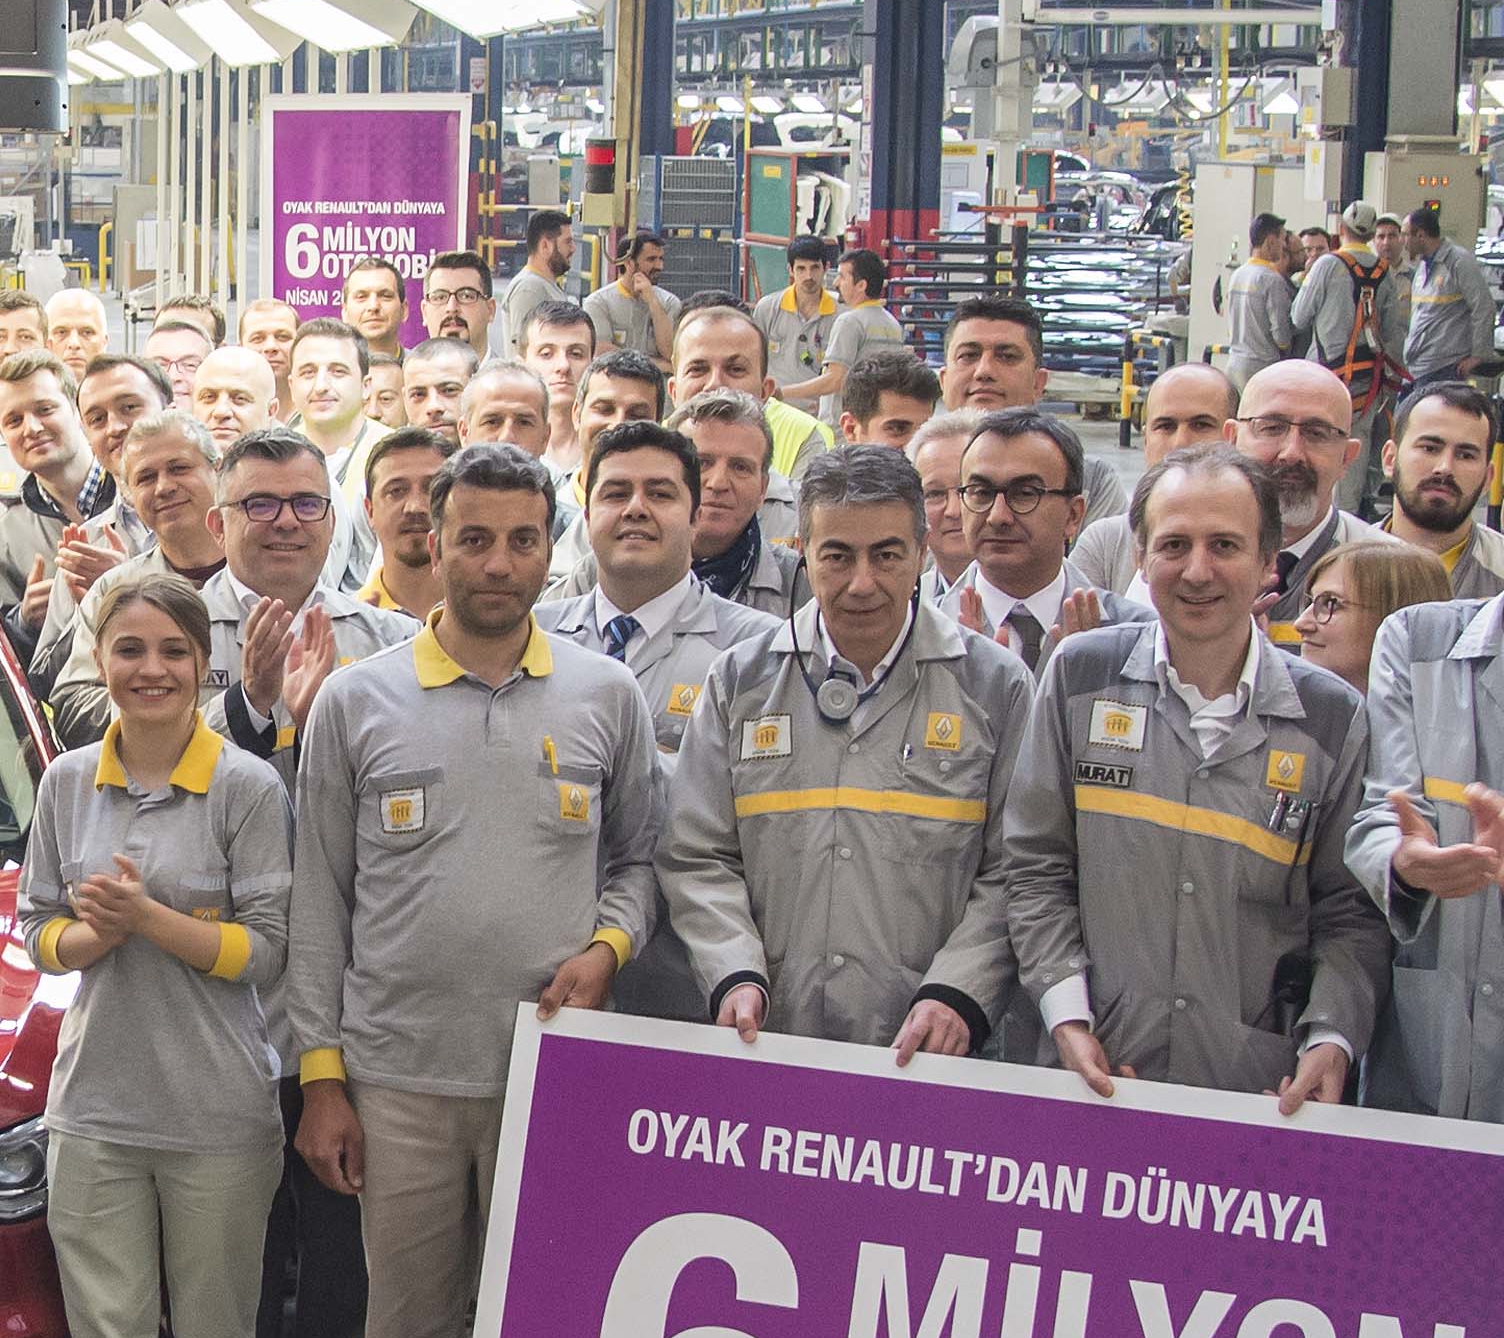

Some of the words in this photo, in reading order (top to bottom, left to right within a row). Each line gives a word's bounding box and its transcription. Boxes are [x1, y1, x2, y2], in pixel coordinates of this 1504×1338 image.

[282, 201, 313, 214] OYAK
[394, 200, 446, 215] DÜNYAYA
[322, 220, 416, 252] MİLYON
[285, 222, 321, 279] 6
[285, 286, 328, 307] NİSAN
[1077, 763, 1129, 784] MURAT
[627, 1108, 750, 1169] OYAK
[1102, 1166, 1328, 1248] DÜNYAYA
